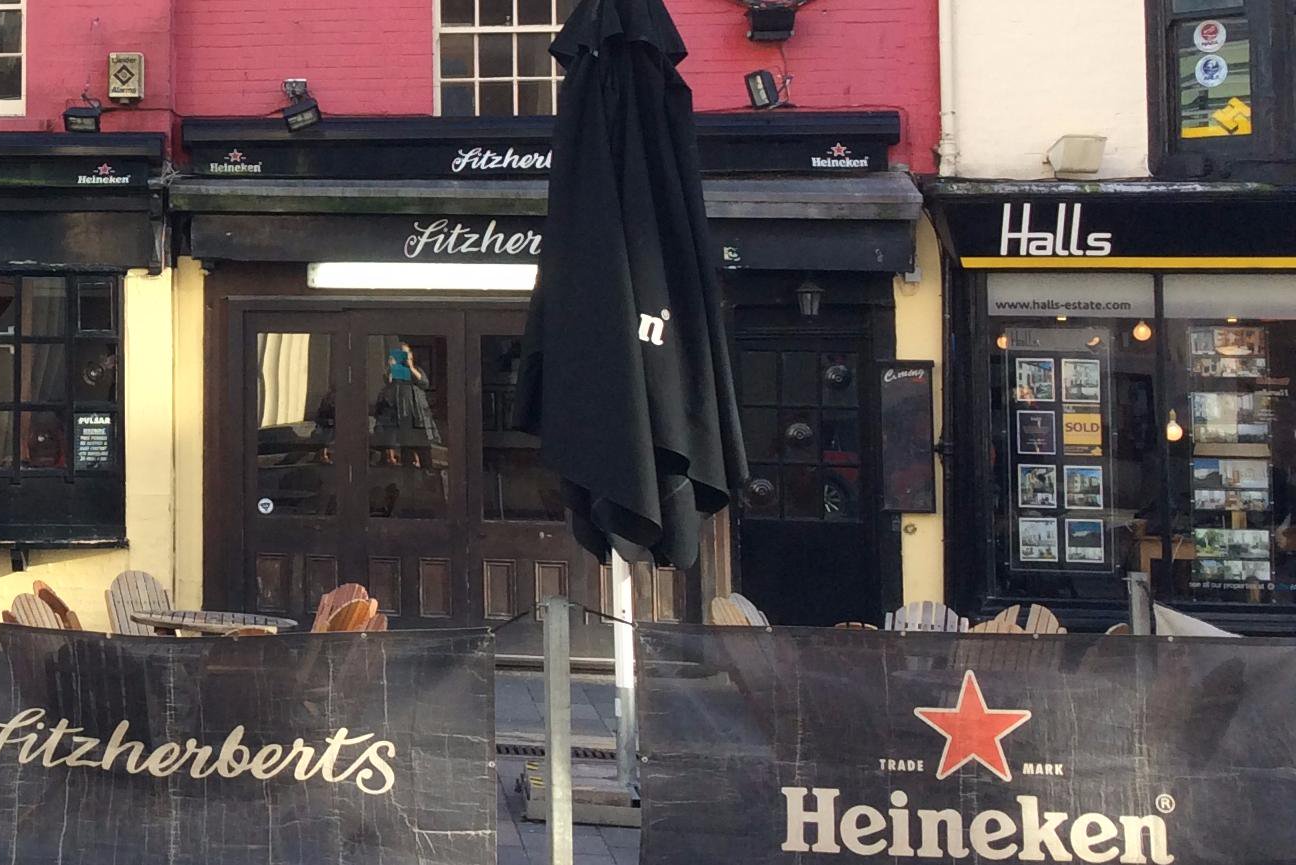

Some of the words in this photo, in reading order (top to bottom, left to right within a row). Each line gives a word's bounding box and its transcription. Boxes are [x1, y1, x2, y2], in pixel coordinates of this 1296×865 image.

[451, 147, 552, 172] Fitzher
[811, 156, 869, 167] Heineken
[210, 162, 262, 173] Heineken
[77, 175, 131, 184] Heineken
[1000, 203, 1112, 256] Halls
[404, 219, 542, 258] Fitzher
[995, 300, 1131, 311] www.halls-estate.com
[1065, 422, 1099, 432] SOLD
[879, 758, 925, 772] TRADE
[1022, 762, 1064, 776] MARK
